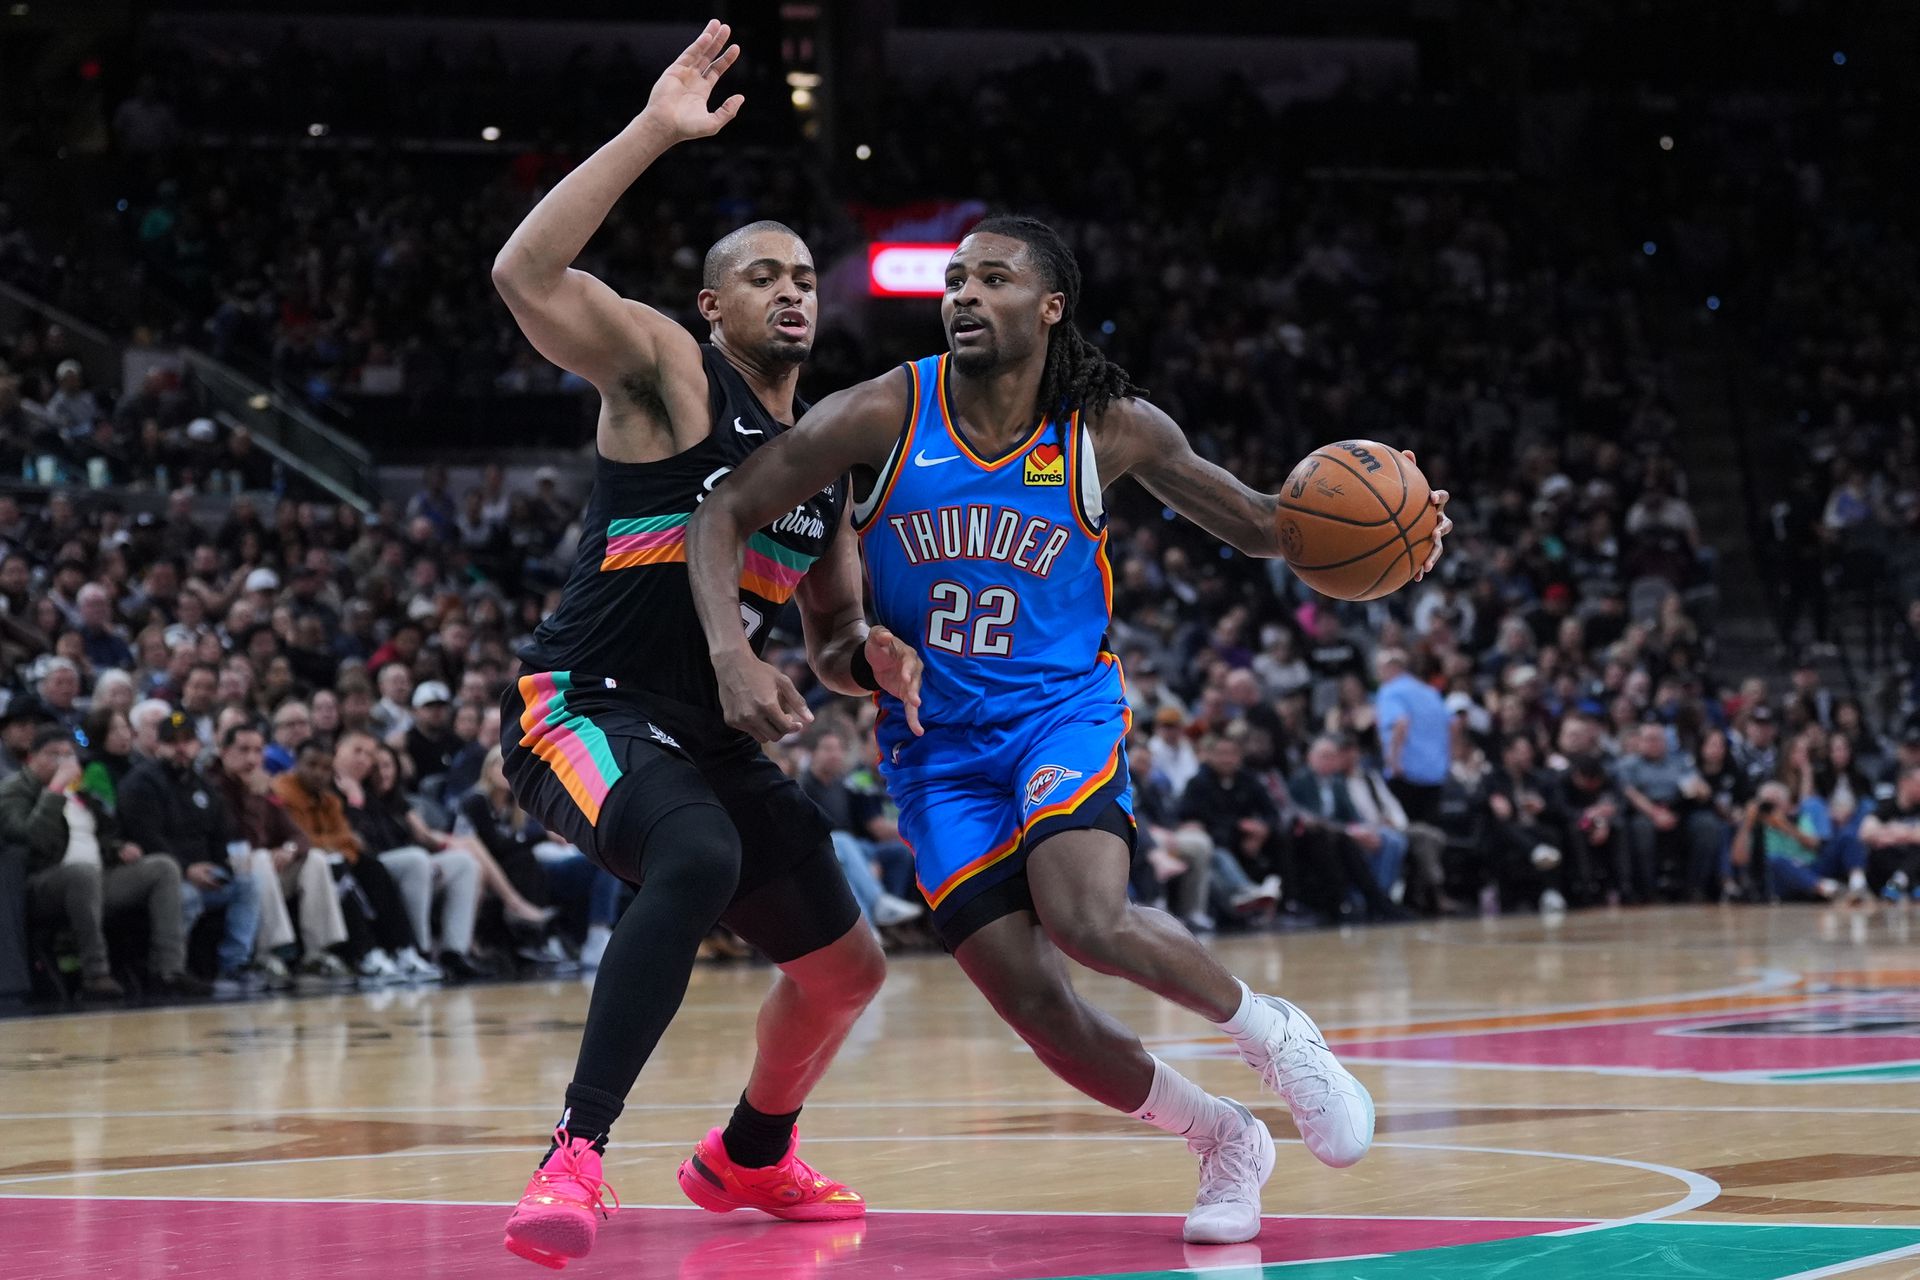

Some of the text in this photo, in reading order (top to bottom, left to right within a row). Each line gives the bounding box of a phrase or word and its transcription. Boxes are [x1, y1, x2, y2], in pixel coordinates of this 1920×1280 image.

[771, 504, 825, 539] ntonio
[889, 504, 1070, 579] THUNDER
[926, 580, 1019, 658] 22
